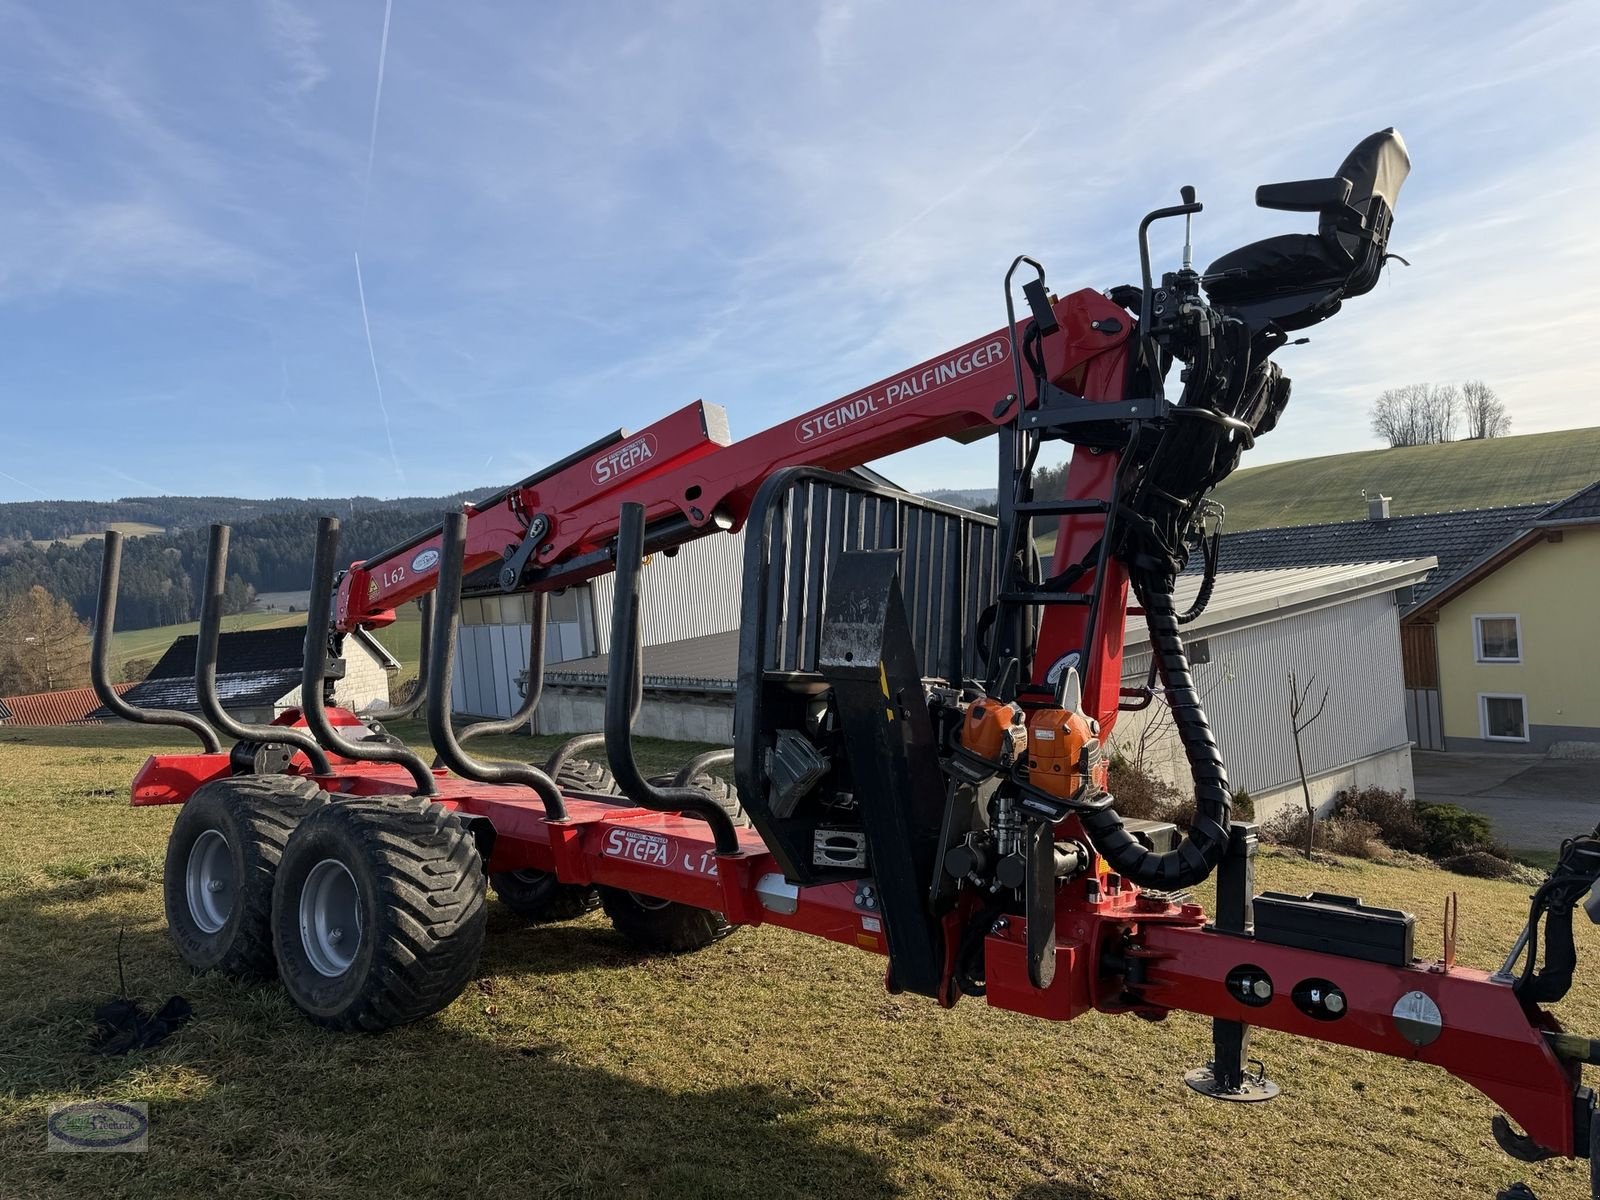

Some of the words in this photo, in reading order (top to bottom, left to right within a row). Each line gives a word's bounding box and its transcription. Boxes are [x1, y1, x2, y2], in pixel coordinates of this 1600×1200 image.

[801, 341, 1003, 440] STEINDL-PALFINGER
[596, 443, 652, 483] STEPA
[383, 566, 405, 588] L62
[606, 829, 667, 865] STEPA
